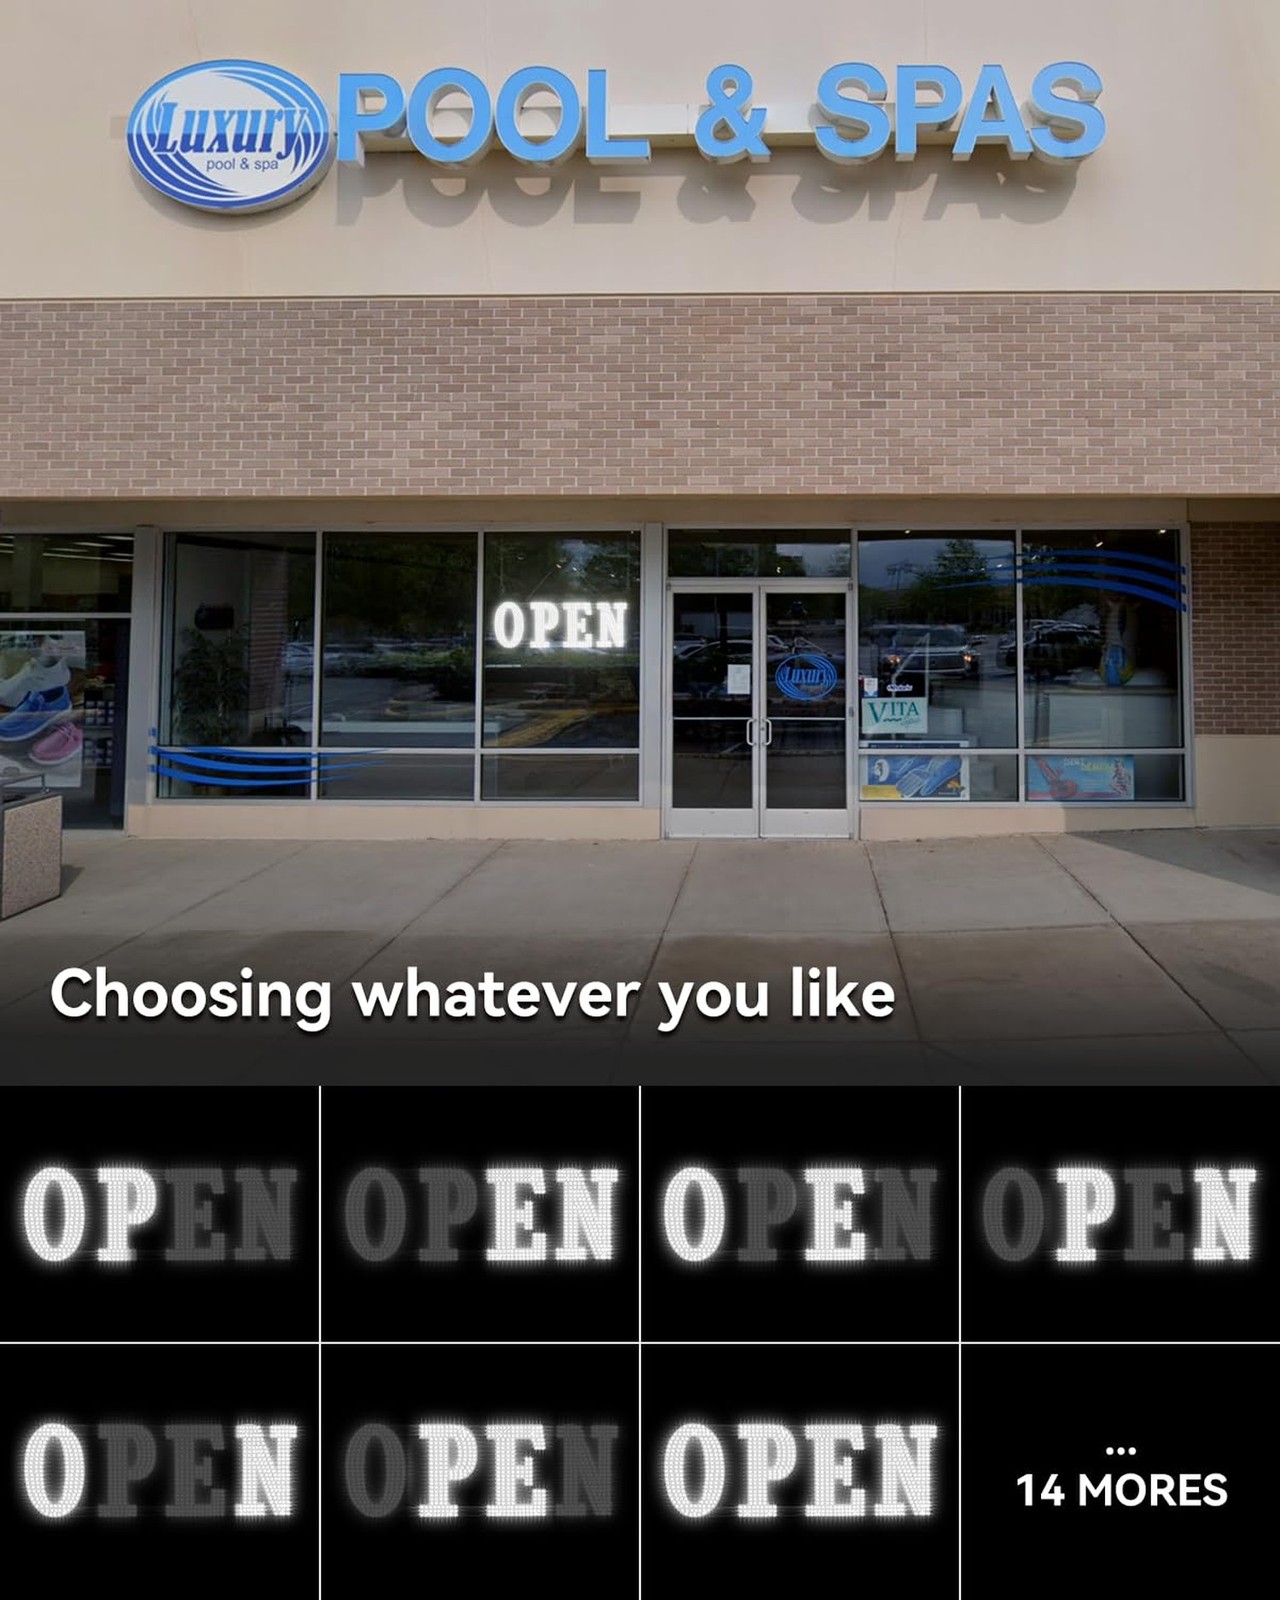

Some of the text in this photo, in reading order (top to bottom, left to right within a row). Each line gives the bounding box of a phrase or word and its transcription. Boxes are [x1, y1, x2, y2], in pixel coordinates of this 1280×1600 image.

[152, 101, 309, 160] Luxury
[337, 61, 1107, 163] POOL & SPAS
[206, 157, 279, 172] pool & spa
[494, 601, 628, 649] OPEN
[867, 700, 920, 724] VITA
[664, 1423, 938, 1518] OPEN
